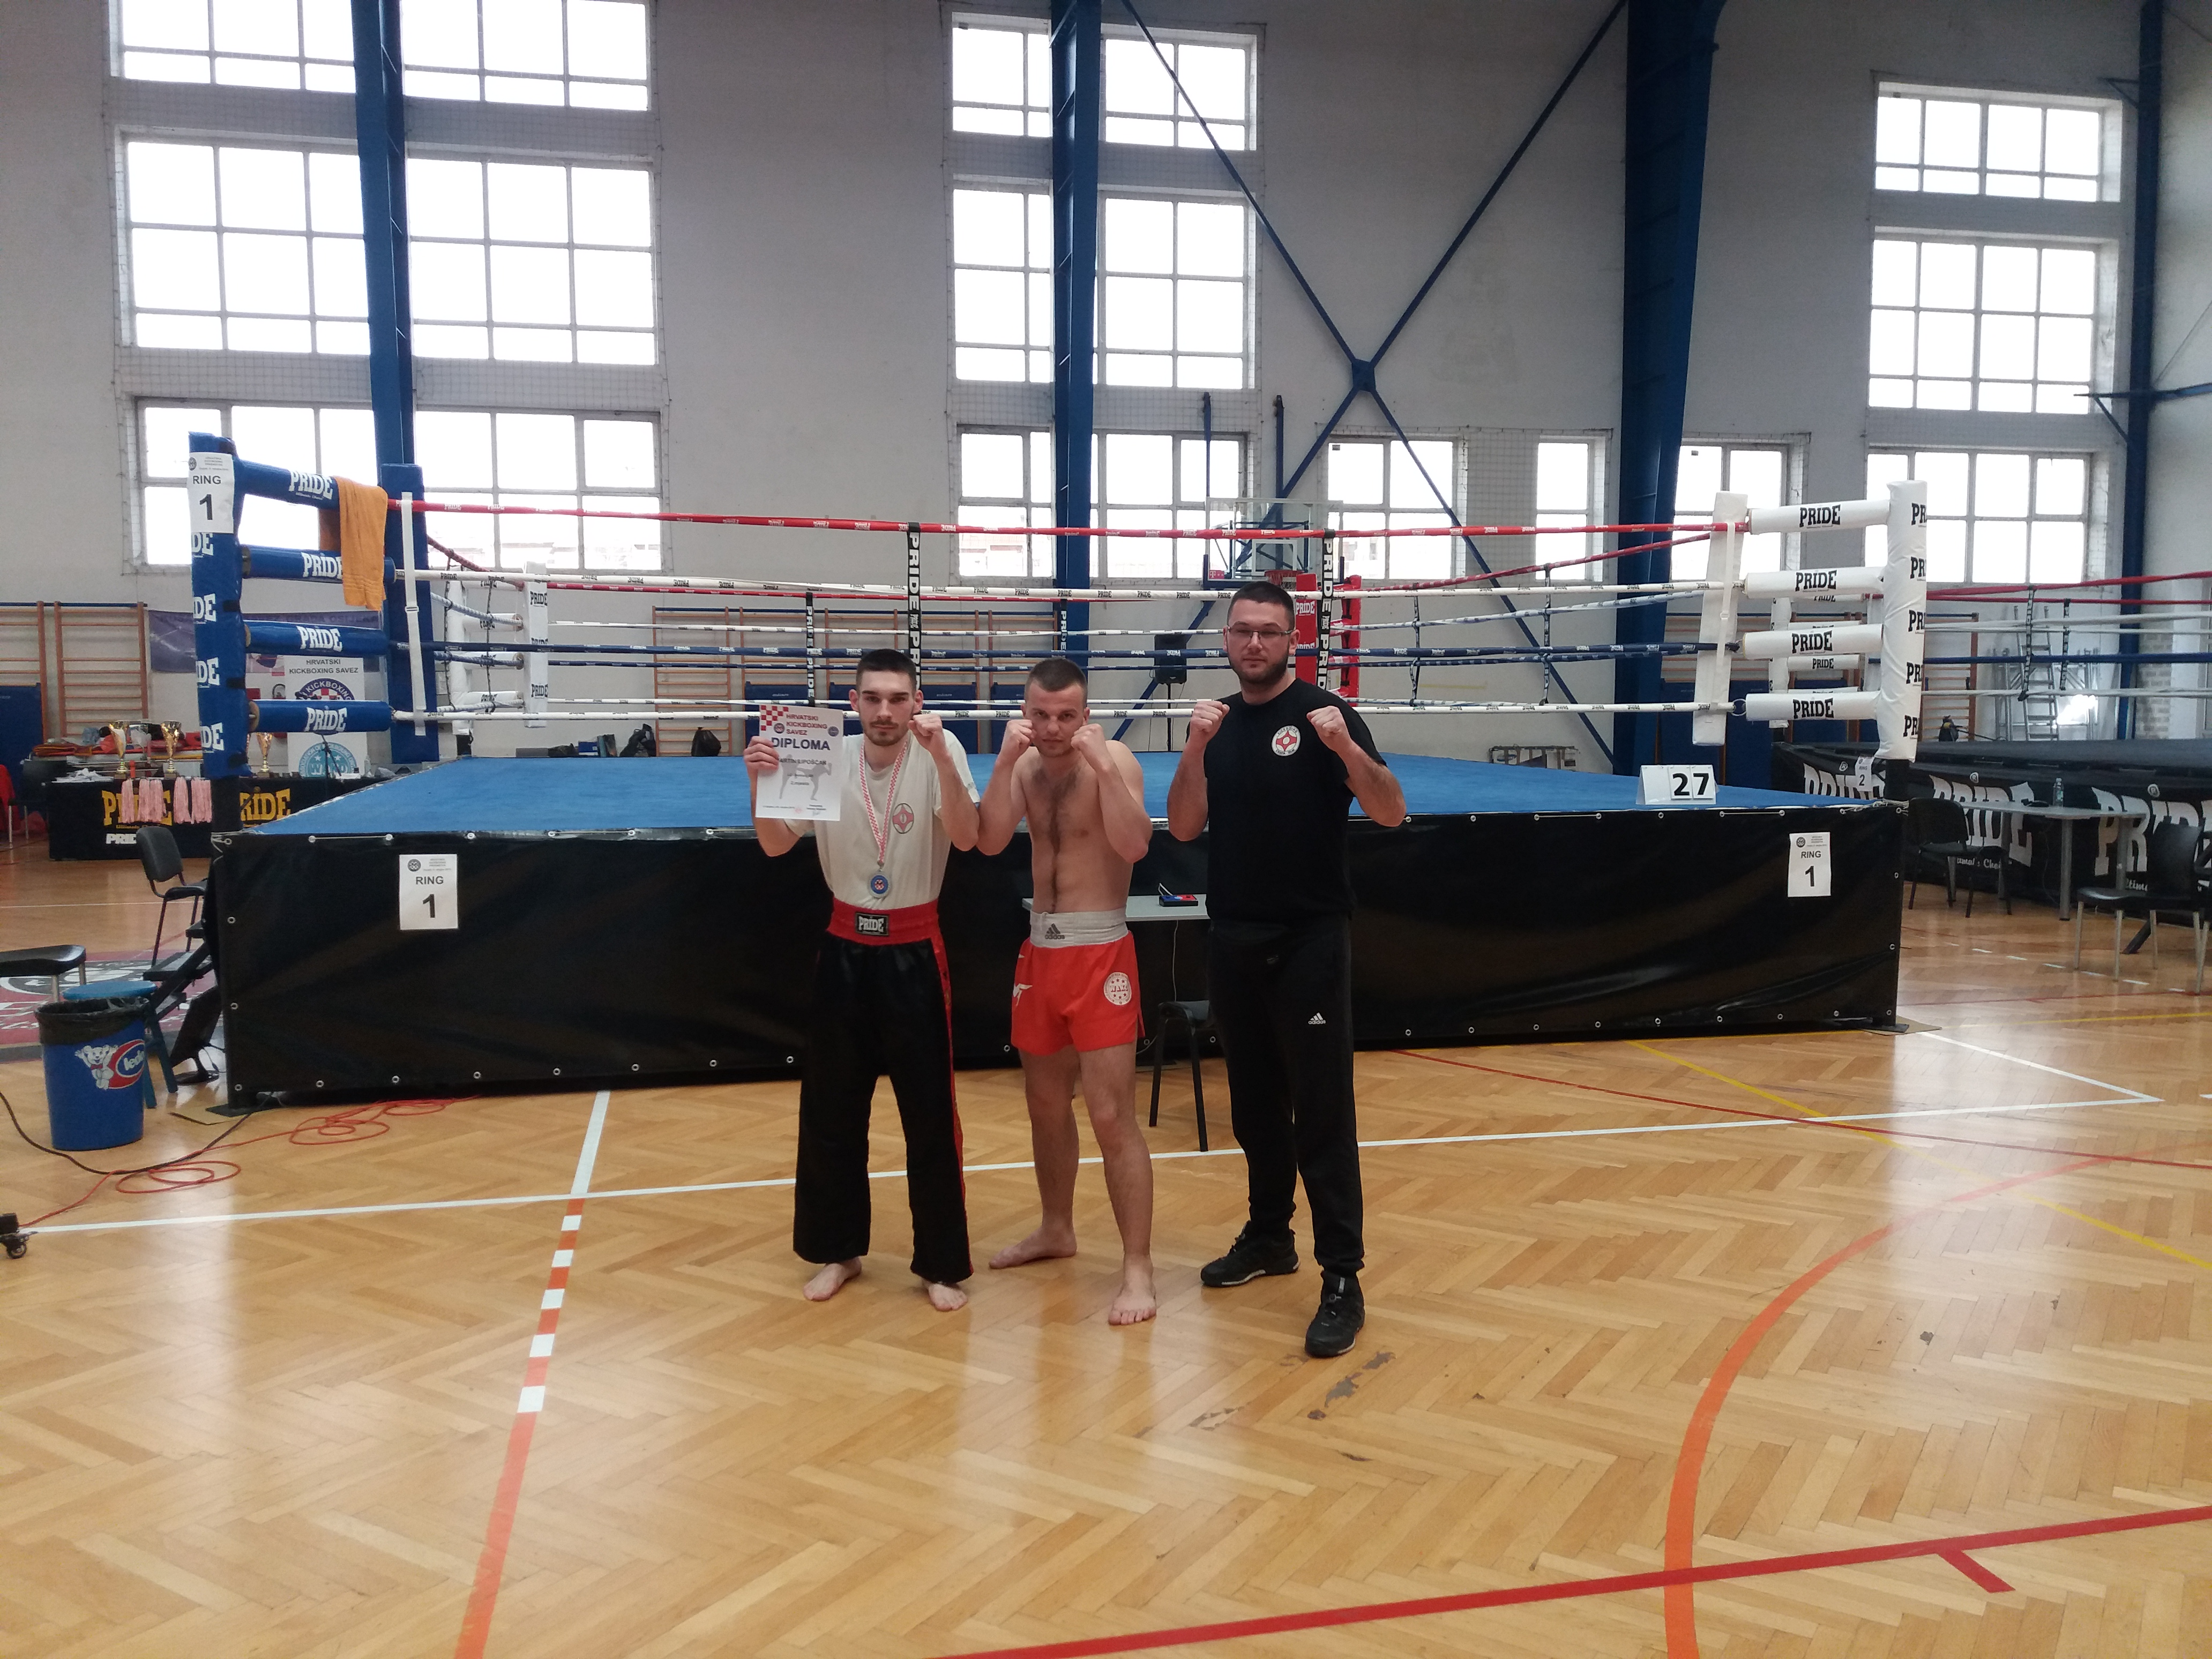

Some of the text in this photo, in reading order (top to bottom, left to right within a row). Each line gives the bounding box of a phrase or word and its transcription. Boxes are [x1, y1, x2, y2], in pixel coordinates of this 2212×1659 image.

[193, 475, 221, 484] RING
[289, 471, 333, 500] PRIDE
[199, 494, 213, 520] 1
[1799, 504, 1841, 528] PRIDE
[440, 572, 457, 580] PRIDE
[674, 579, 690, 587] PRIDE
[909, 533, 920, 611] PRIDE
[1321, 538, 1334, 612] PRIDE
[1795, 570, 1837, 592] PRIDE
[530, 591, 548, 606] PRIDE
[1296, 601, 1315, 615] PRIDE
[296, 625, 343, 652] PRIDE
[1792, 630, 1833, 654] PRIDE
[1812, 658, 1834, 669] PRIDE
[531, 683, 548, 698] PRIDE
[304, 707, 347, 732] PRIDE
[1792, 698, 1834, 719] PRIDE
[772, 737, 831, 750] DIPLOMA
[1672, 773, 1709, 796] 27
[1859, 774, 1865, 786] 2
[240, 788, 291, 821] RIDE
[416, 876, 444, 885] RING
[1805, 865, 1815, 887] 1
[423, 894, 436, 918] 1
[858, 916, 884, 932] PRIDE
